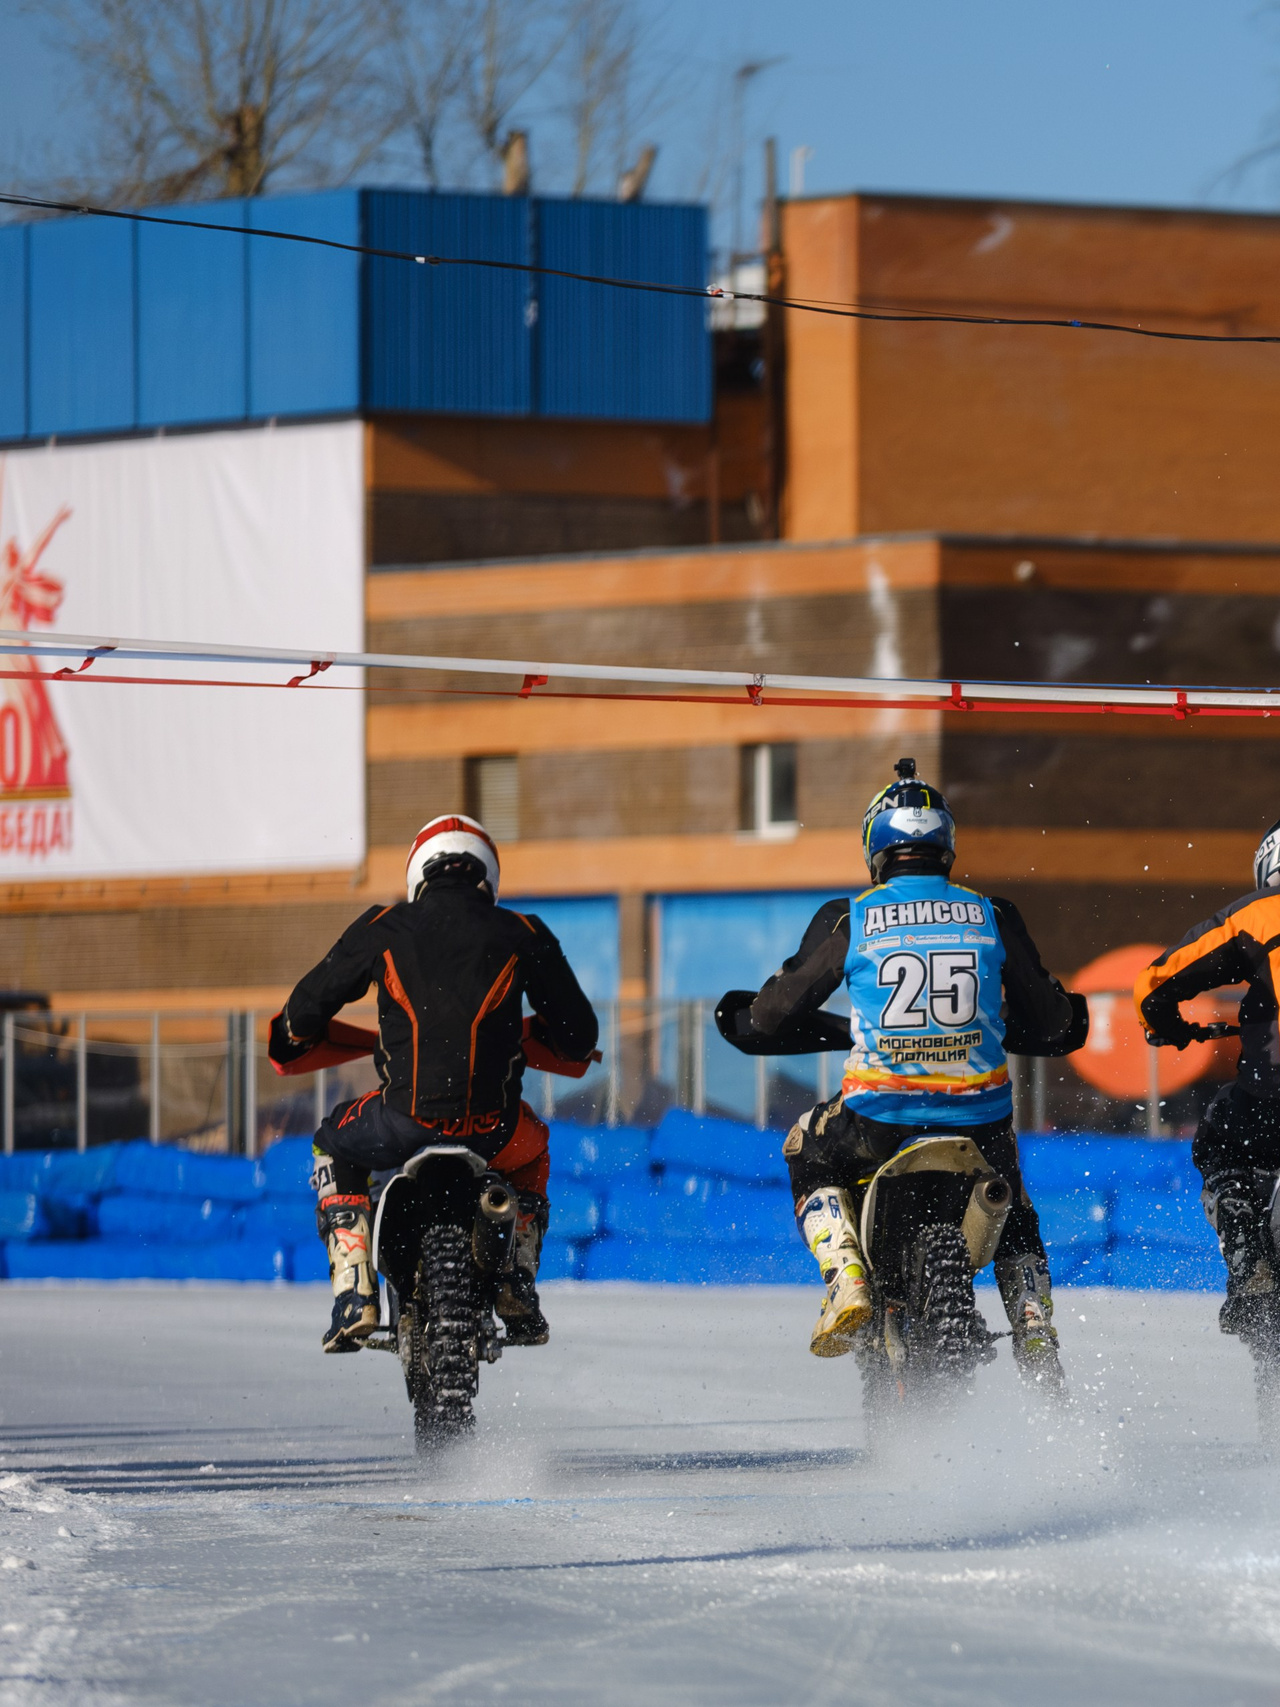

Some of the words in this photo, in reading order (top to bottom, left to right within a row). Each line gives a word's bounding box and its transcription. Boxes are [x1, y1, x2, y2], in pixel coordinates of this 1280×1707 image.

[864, 901, 985, 936] ДЕНИСОВ
[878, 951, 979, 1030] 25
[879, 1032, 980, 1049] МОСКОВСКАЯ
[895, 1049, 967, 1062] ПОЛИЦИЯ
